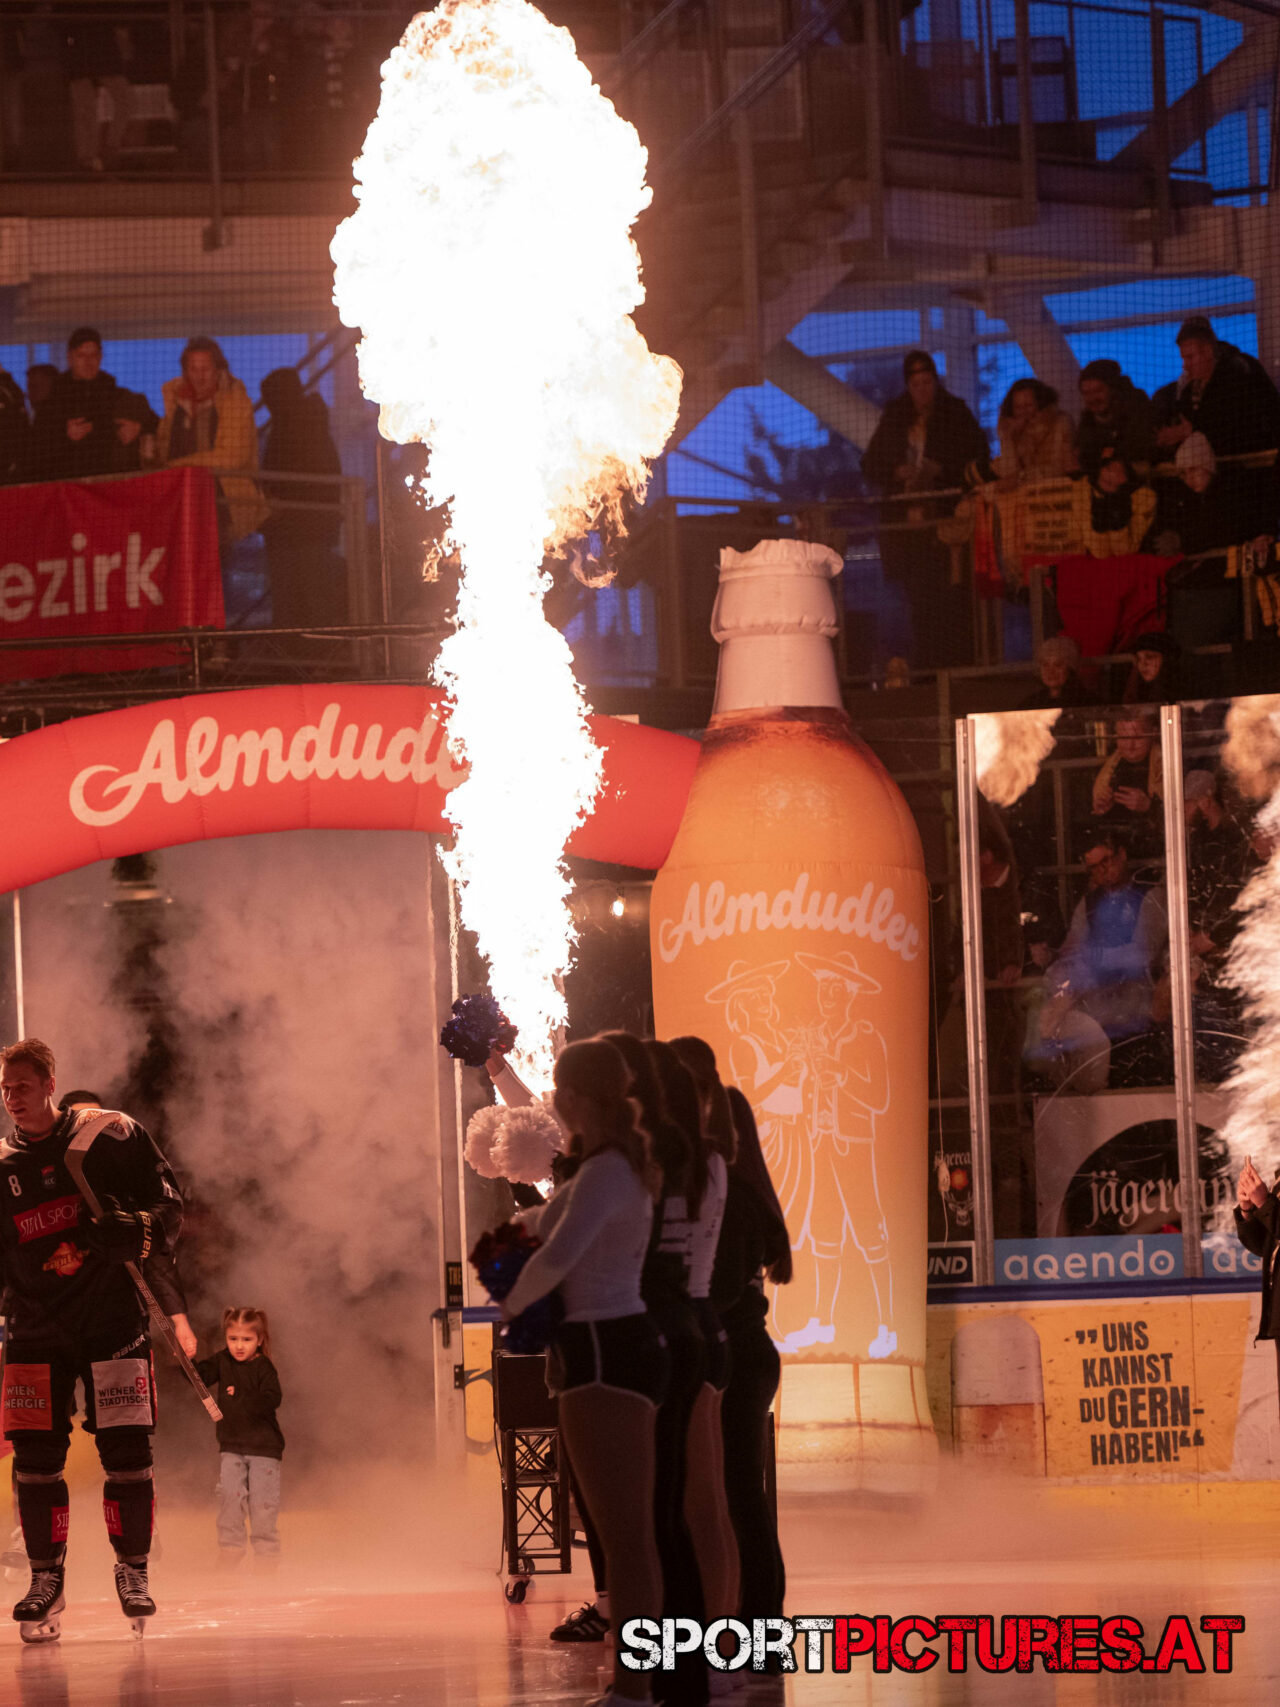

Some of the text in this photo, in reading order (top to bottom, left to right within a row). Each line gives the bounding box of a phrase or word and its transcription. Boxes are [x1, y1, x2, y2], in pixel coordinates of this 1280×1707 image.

[69, 704, 473, 827] Almdudl
[659, 872, 919, 962] Almdudler
[8, 1175, 22, 1196] 8
[1082, 1353, 1173, 1388] KANNST
[4, 1398, 46, 1410] NERGIE
[6, 1386, 36, 1396] WIEN
[98, 1386, 135, 1398] WIENER
[1079, 1386, 1205, 1429] DU GERN-
